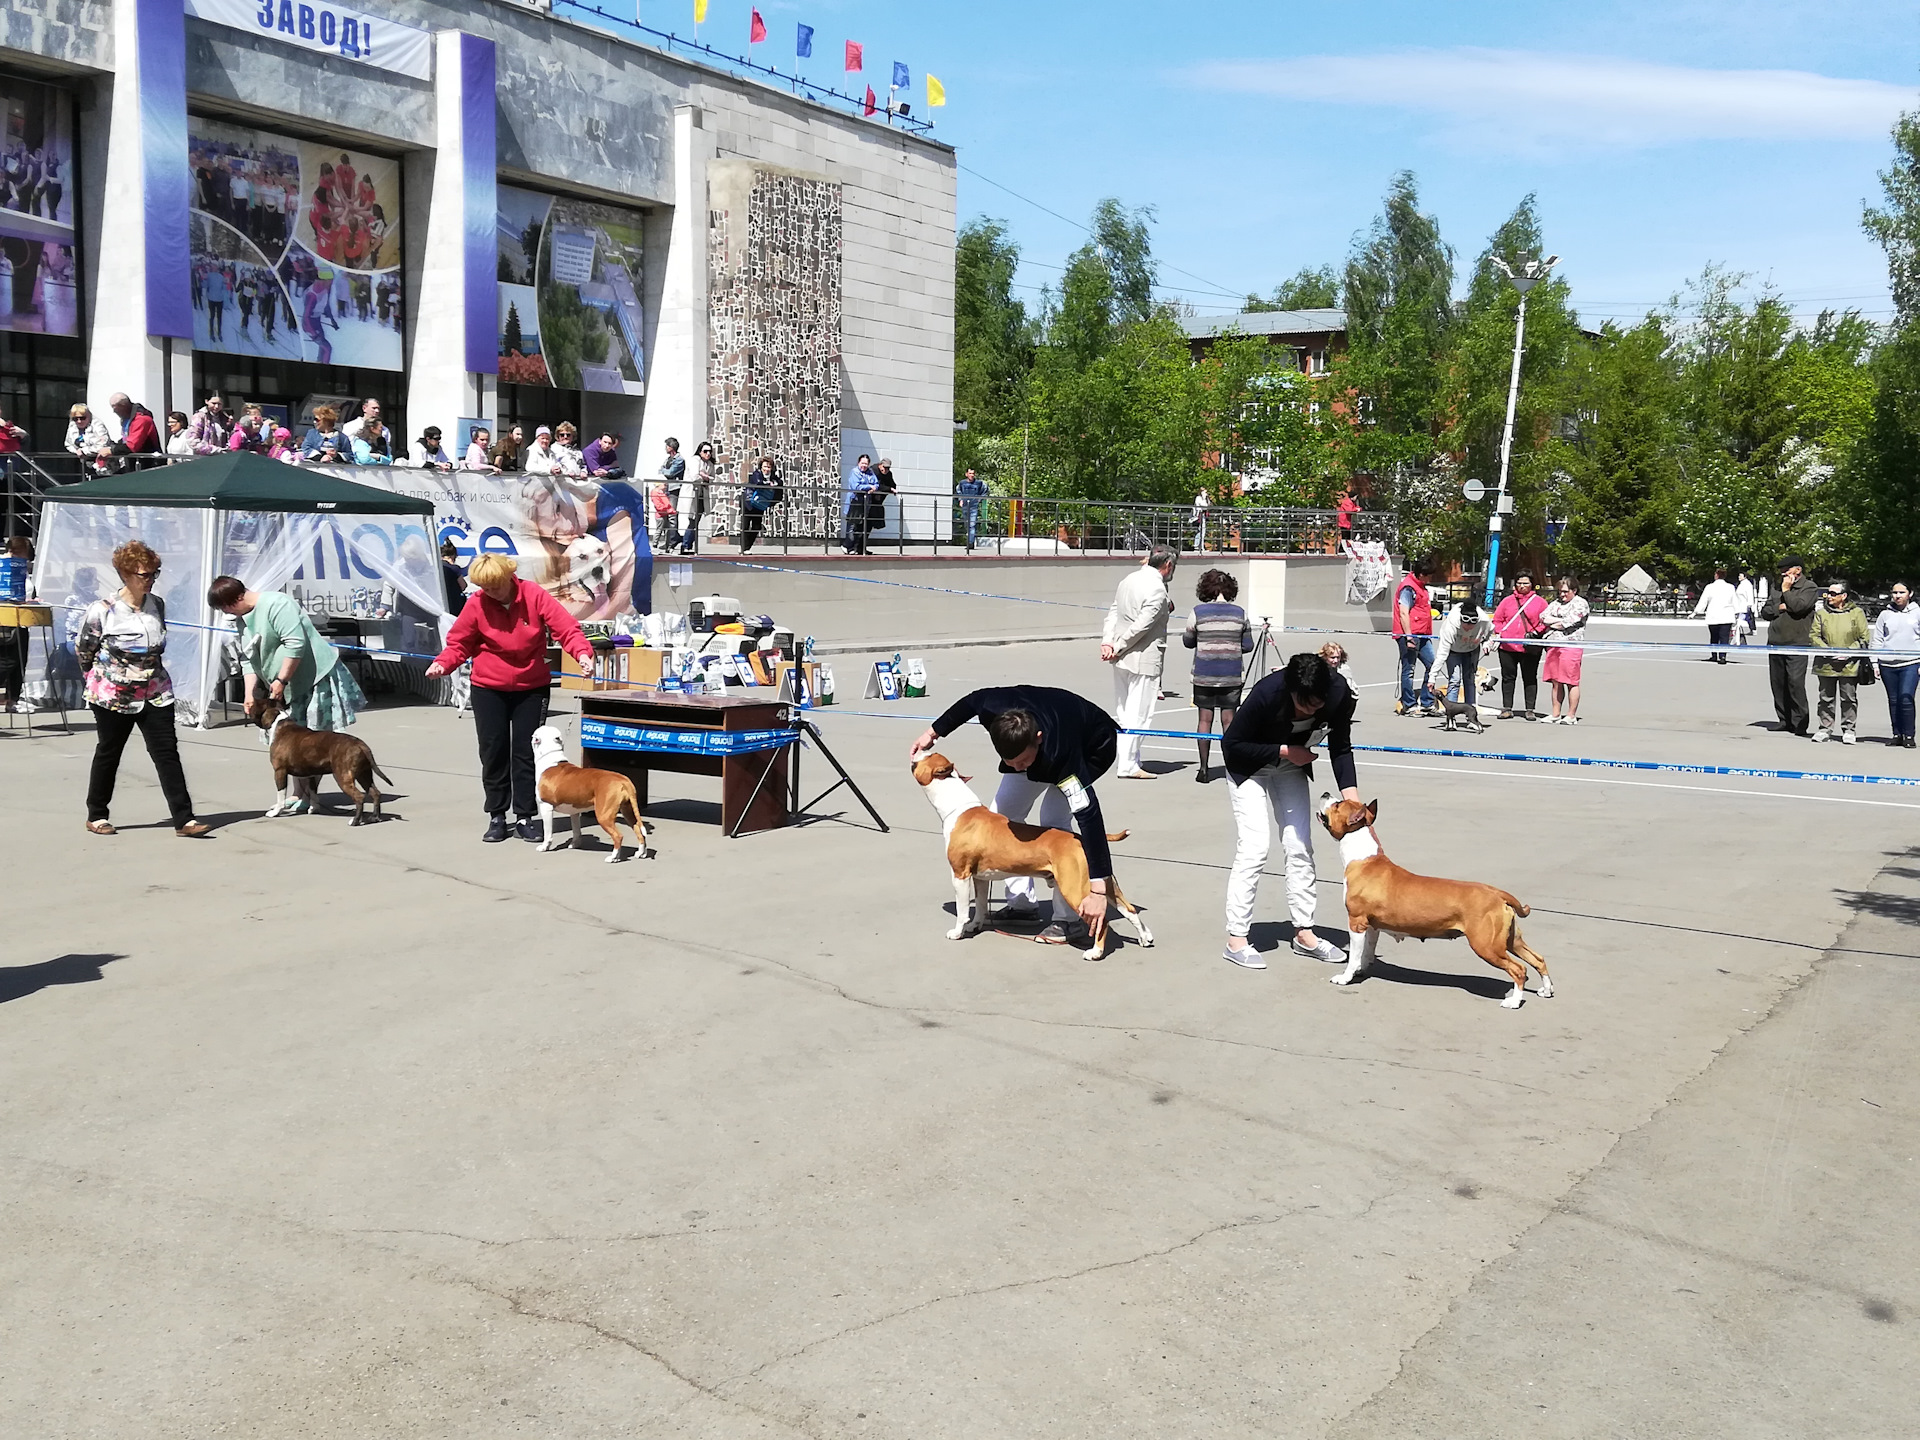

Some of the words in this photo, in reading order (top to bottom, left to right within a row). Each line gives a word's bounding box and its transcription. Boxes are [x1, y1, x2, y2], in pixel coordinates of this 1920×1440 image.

[257, 0, 371, 58] ЗАВОД!
[433, 488, 467, 503] собак
[470, 494, 477, 502] и
[480, 493, 513, 504] кошек
[743, 666, 752, 678] 4
[883, 676, 892, 691] 3
[776, 709, 787, 720] 42
